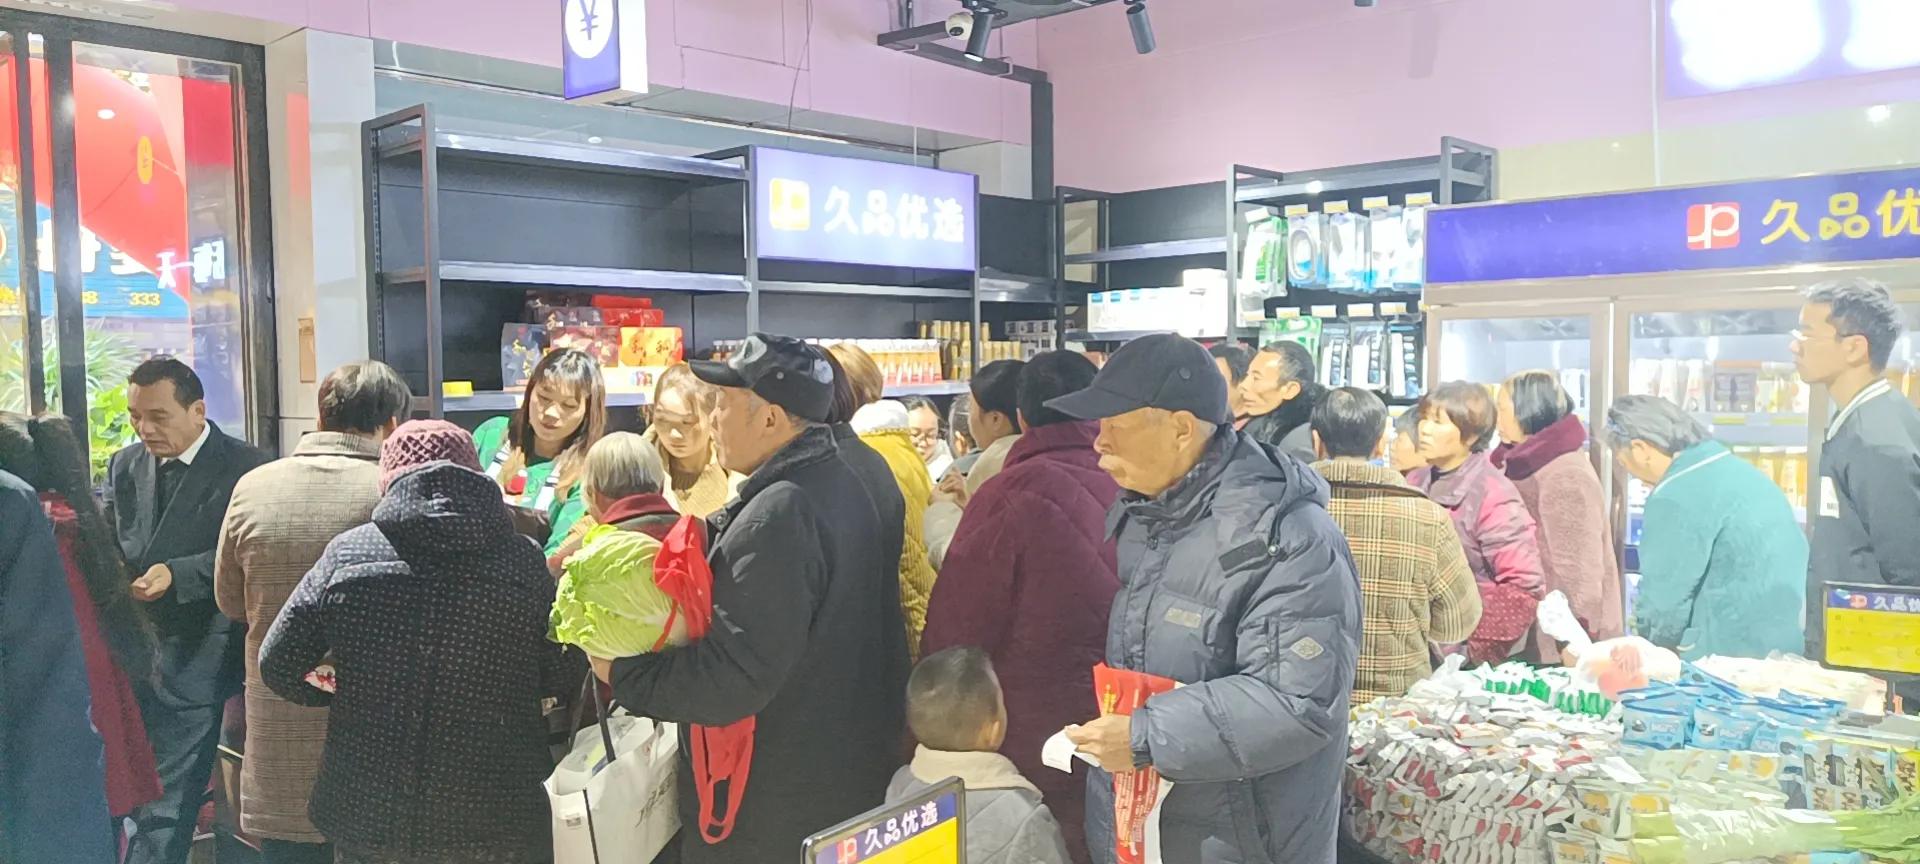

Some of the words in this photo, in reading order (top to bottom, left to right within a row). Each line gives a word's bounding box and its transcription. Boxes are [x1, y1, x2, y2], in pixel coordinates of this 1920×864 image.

[823, 186, 965, 243] 久品优选
[1761, 187, 1920, 245] 久品优
[129, 292, 160, 306] 333
[865, 801, 938, 855] 久品优选
